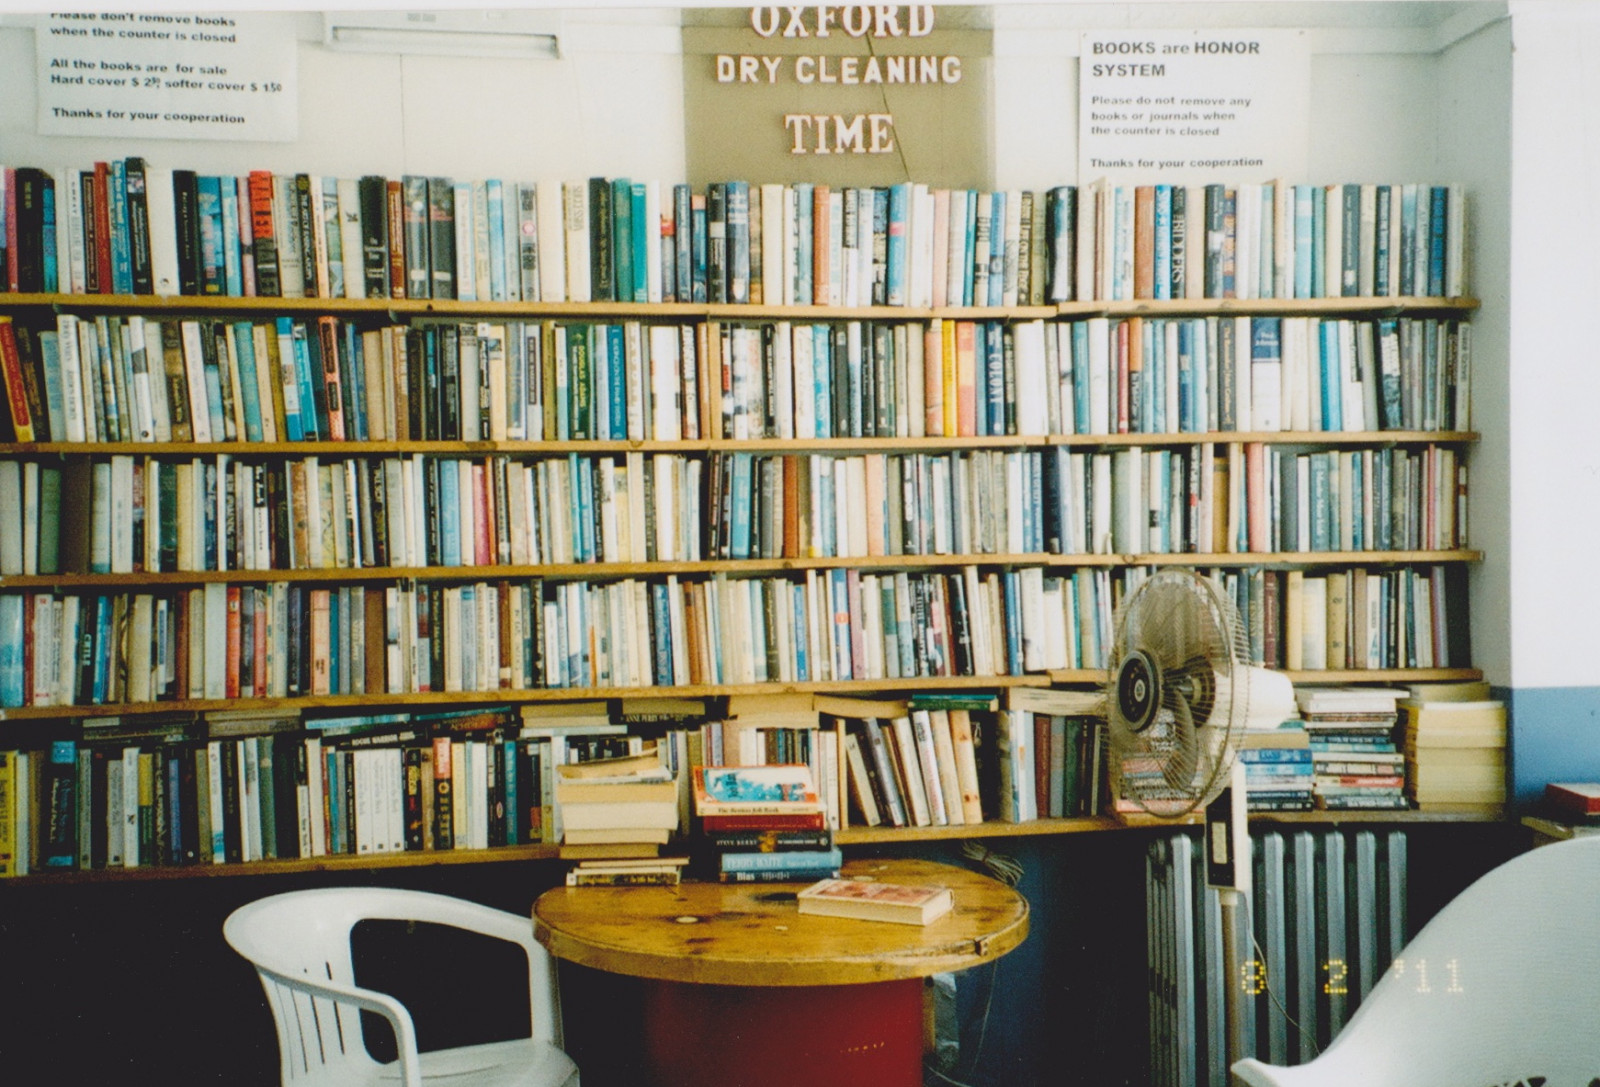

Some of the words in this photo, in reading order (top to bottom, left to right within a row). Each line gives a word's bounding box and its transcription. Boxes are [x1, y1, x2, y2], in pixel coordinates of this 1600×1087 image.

[139, 14, 191, 24] remove
[195, 17, 236, 27] books
[752, 6, 935, 38] OXFORD
[50, 27, 88, 36] when
[92, 28, 115, 38] the
[118, 30, 170, 40] counter
[175, 31, 188, 41] is
[191, 33, 236, 43] closed
[1093, 41, 1157, 55] BOOKS
[1162, 43, 1190, 55] are
[1194, 40, 1260, 55] HONOR
[50, 58, 69, 68] All
[73, 59, 96, 70] the
[100, 60, 142, 72] books
[145, 64, 168, 72] are
[175, 64, 194, 75] for
[200, 65, 228, 75] sale
[716, 55, 782, 84] DRY
[795, 55, 963, 85] CLEANING
[1092, 64, 1166, 77] SYSTEM
[51, 74, 84, 84] Hard
[88, 77, 127, 87] cover
[130, 77, 141, 88] $
[164, 79, 204, 90] softer
[208, 81, 246, 92] cover
[250, 83, 259, 93] $
[1092, 96, 1133, 106] Please
[1136, 96, 1152, 106] do
[1155, 96, 1176, 106] not
[1180, 97, 1226, 106] remove
[1229, 98, 1253, 107] any
[52, 107, 103, 119] Thanks
[107, 109, 125, 119] for
[129, 111, 159, 121] your
[163, 112, 246, 124] cooperation
[1091, 111, 1129, 121] books
[1131, 113, 1145, 121] or
[1149, 111, 1200, 123] journals
[1202, 112, 1236, 121] when
[784, 112, 894, 154] TIME
[1091, 126, 1111, 135] the
[1114, 127, 1162, 135] counter
[1165, 126, 1177, 135] is
[1180, 126, 1221, 136] closed
[1091, 158, 1135, 168] Thanks
[1138, 158, 1155, 168] for
[1158, 160, 1186, 171] your
[1189, 157, 1265, 169] cooperation
[1172, 222, 1186, 283] BIDDERS
[577, 345, 587, 380] DOUGLAS
[988, 353, 1003, 404] COLONY
[578, 381, 588, 408] ADAMS
